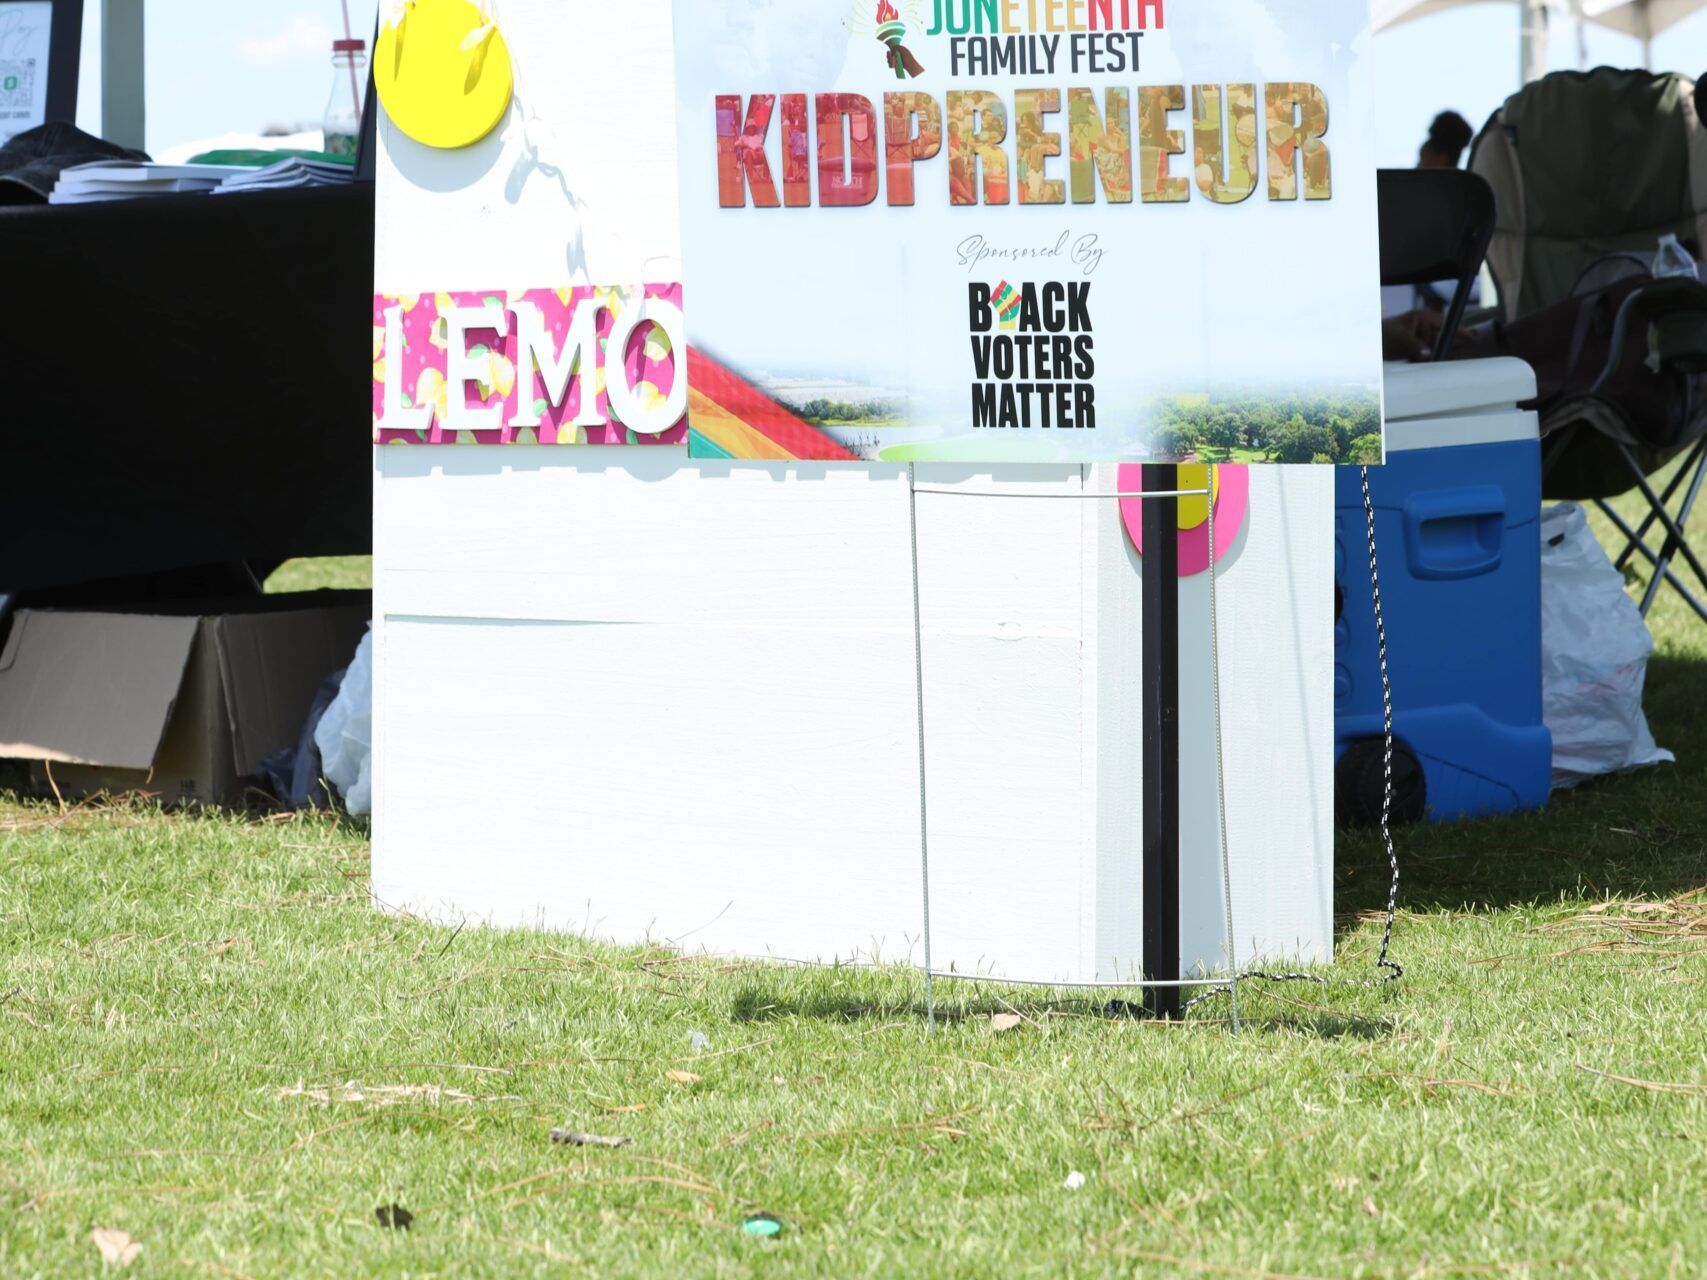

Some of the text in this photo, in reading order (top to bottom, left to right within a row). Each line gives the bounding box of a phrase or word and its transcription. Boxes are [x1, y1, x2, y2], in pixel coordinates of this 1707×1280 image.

[950, 32, 1144, 77] FAMILY FEST
[715, 81, 1333, 207] KIDPRENEUR
[956, 229, 1109, 276] Sponsored By
[376, 297, 688, 434] LEMO
[970, 334, 1095, 380] VOTERS
[971, 382, 1096, 429] MATTER
